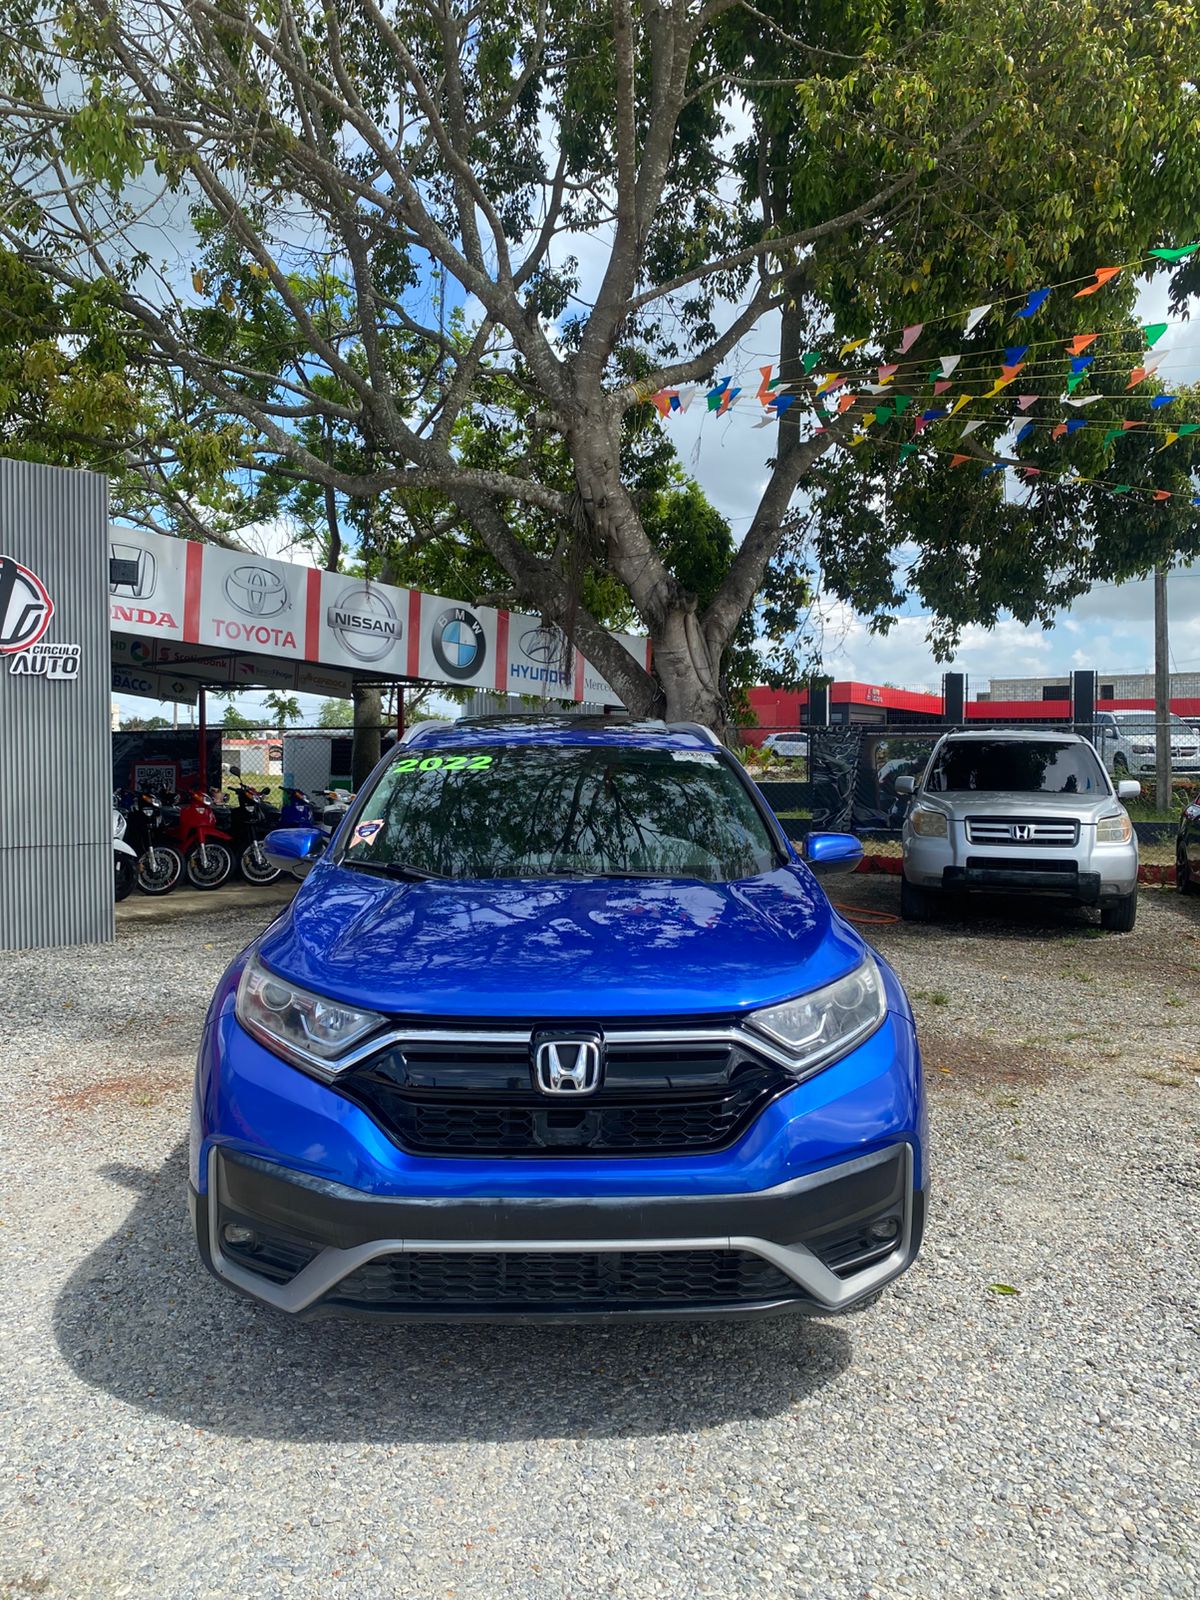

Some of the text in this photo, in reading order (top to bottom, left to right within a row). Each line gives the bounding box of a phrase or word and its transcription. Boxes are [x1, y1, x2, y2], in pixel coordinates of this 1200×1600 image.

[109, 605, 179, 628] NDA
[334, 612, 396, 634] NISSAN
[438, 608, 483, 635] BMW
[212, 618, 297, 649] TOYOTA
[32, 645, 79, 656] CIRCULO
[111, 639, 127, 651] HD
[12, 655, 78, 674] AUTO
[174, 652, 227, 668] Scotibank
[584, 678, 613, 692] Merce
[393, 755, 493, 773] 2022
